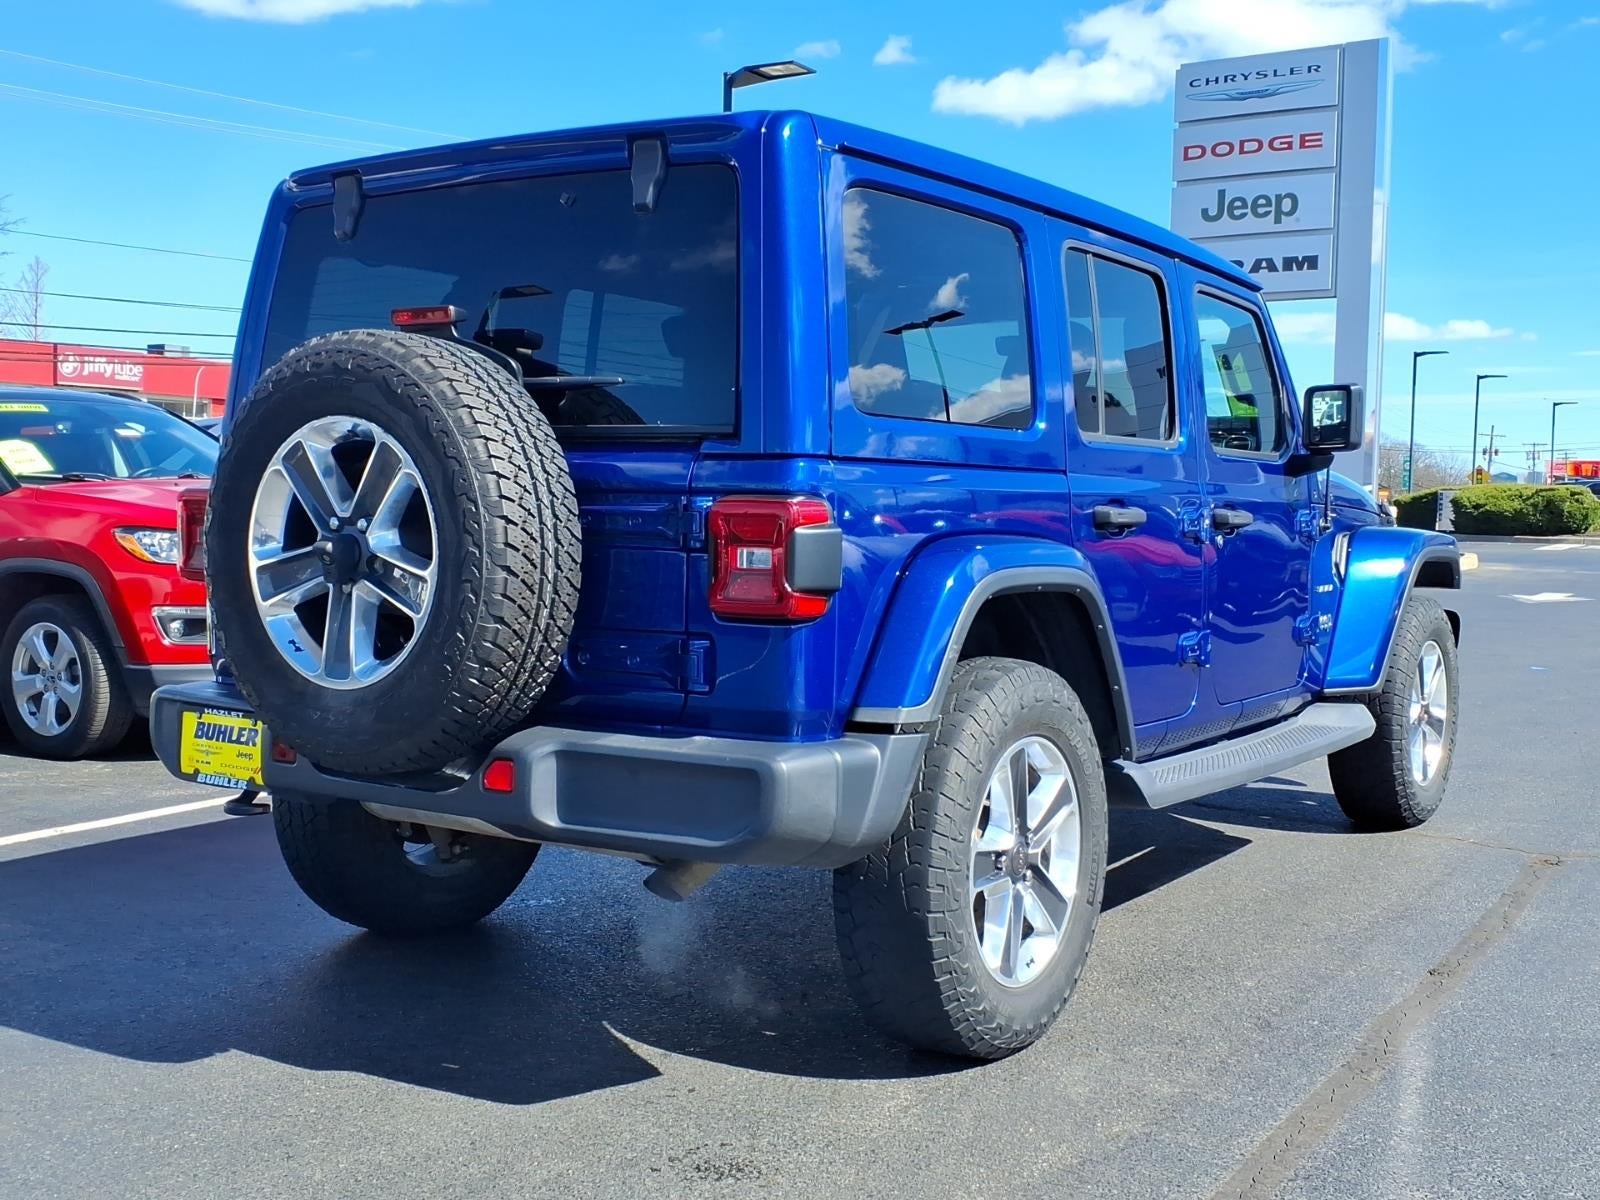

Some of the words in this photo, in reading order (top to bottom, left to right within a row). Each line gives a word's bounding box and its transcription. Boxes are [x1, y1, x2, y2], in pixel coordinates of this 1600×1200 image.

[1188, 64, 1323, 88] CHRYSLER
[1182, 132, 1324, 162] DODGE
[1200, 188, 1299, 225] Jeep
[205, 708, 244, 718] HAZLET
[195, 721, 258, 747] BUHLER
[236, 750, 253, 762] Jeep
[197, 774, 247, 789] BUHLER
